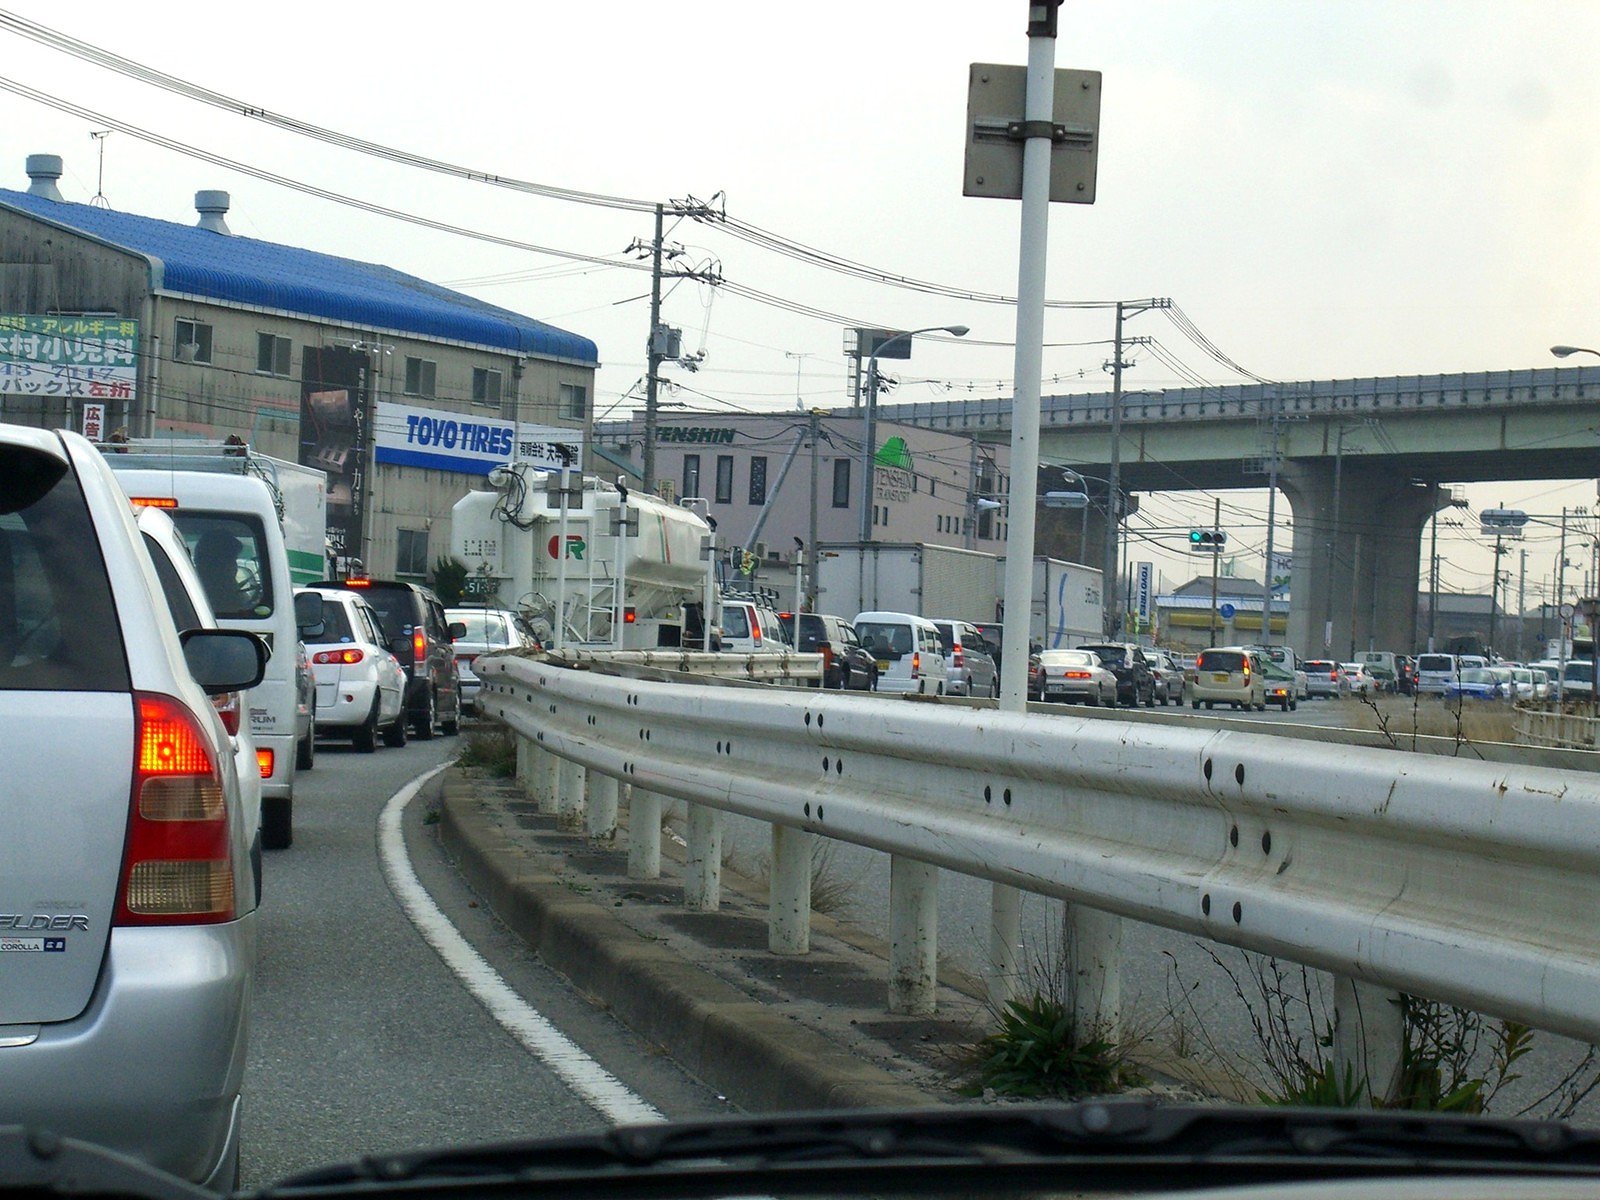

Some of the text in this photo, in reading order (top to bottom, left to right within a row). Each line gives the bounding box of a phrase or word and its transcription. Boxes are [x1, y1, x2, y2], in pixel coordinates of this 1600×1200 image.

[0, 334, 135, 364] 村小児科
[407, 414, 459, 449] TOYO
[460, 422, 514, 456] TIRES
[1139, 566, 1148, 617] TOYO TIRES
[1, 943, 40, 951] COROLLA
